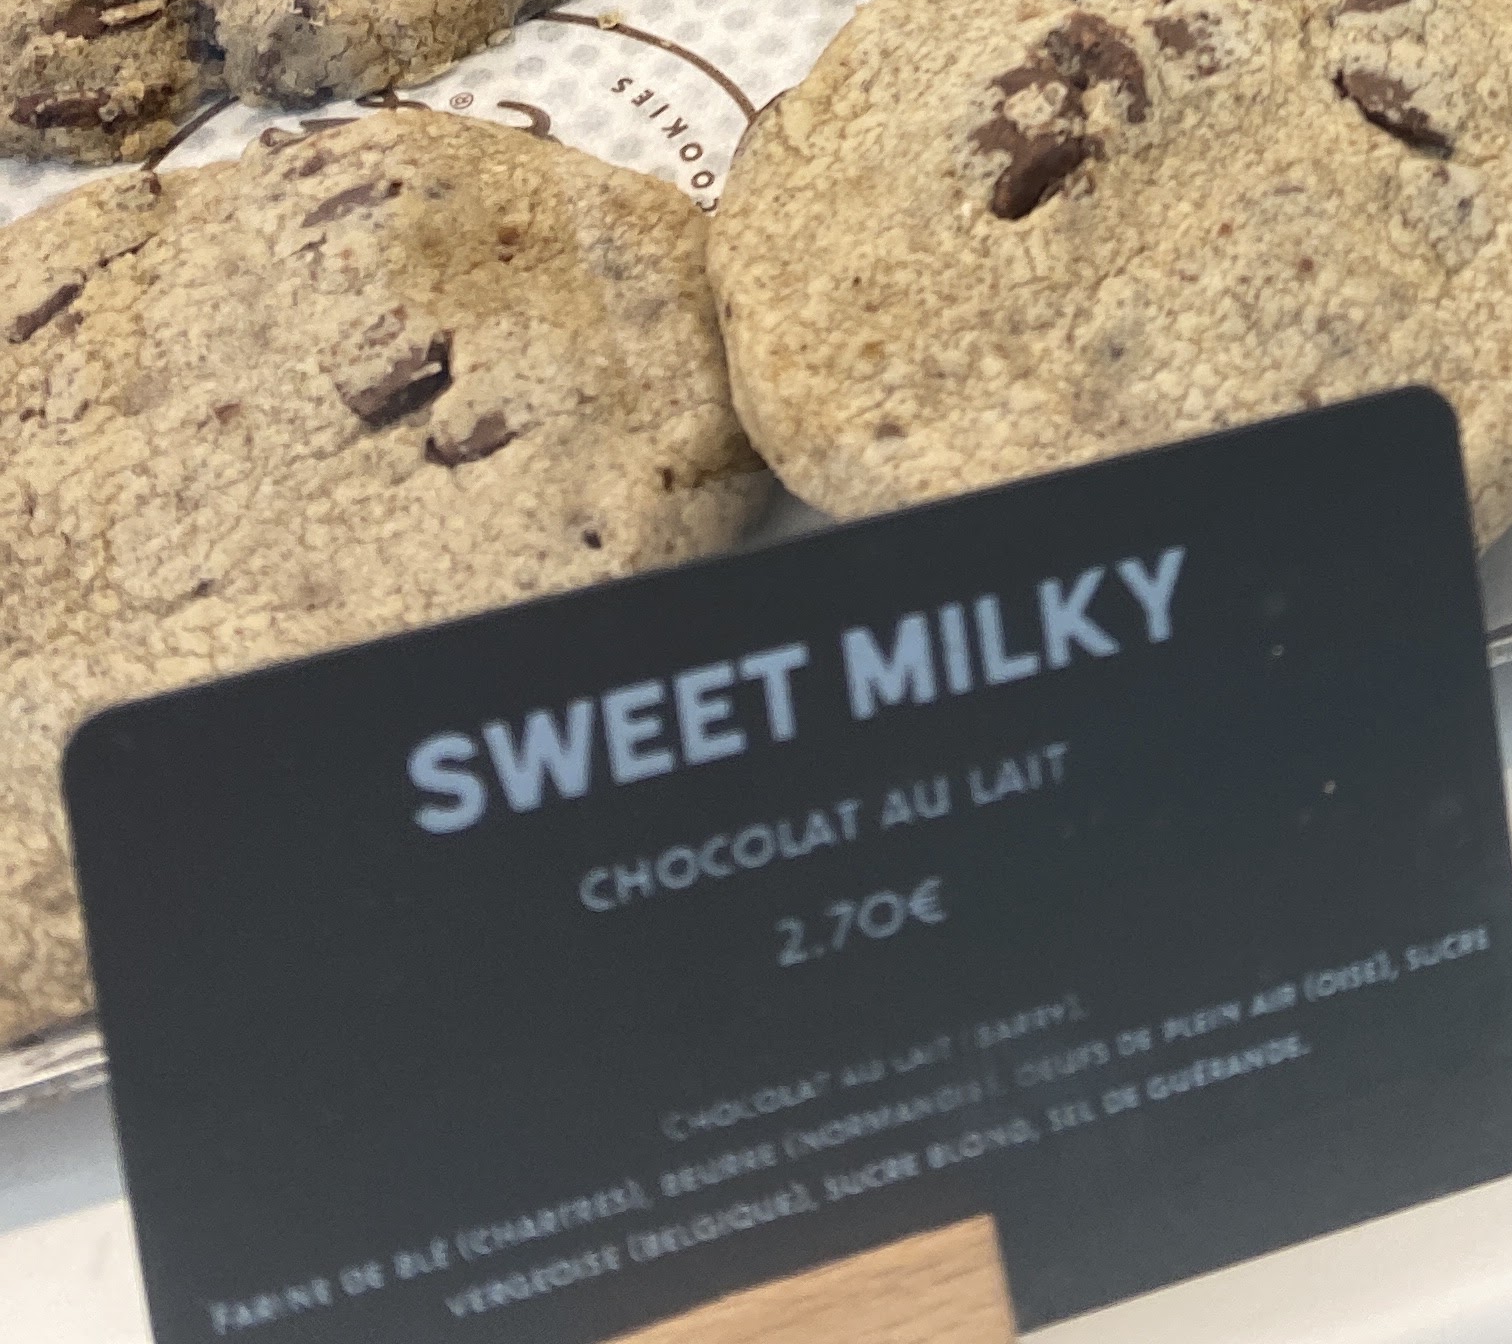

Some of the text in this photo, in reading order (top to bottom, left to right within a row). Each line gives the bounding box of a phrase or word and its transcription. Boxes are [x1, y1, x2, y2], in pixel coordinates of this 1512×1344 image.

[609, 76, 720, 213] COOKIES
[405, 544, 1189, 836] SWEET MILKY
[578, 741, 1070, 913] CHOCOLAT AU LAIT
[777, 875, 949, 968] 2.70€
